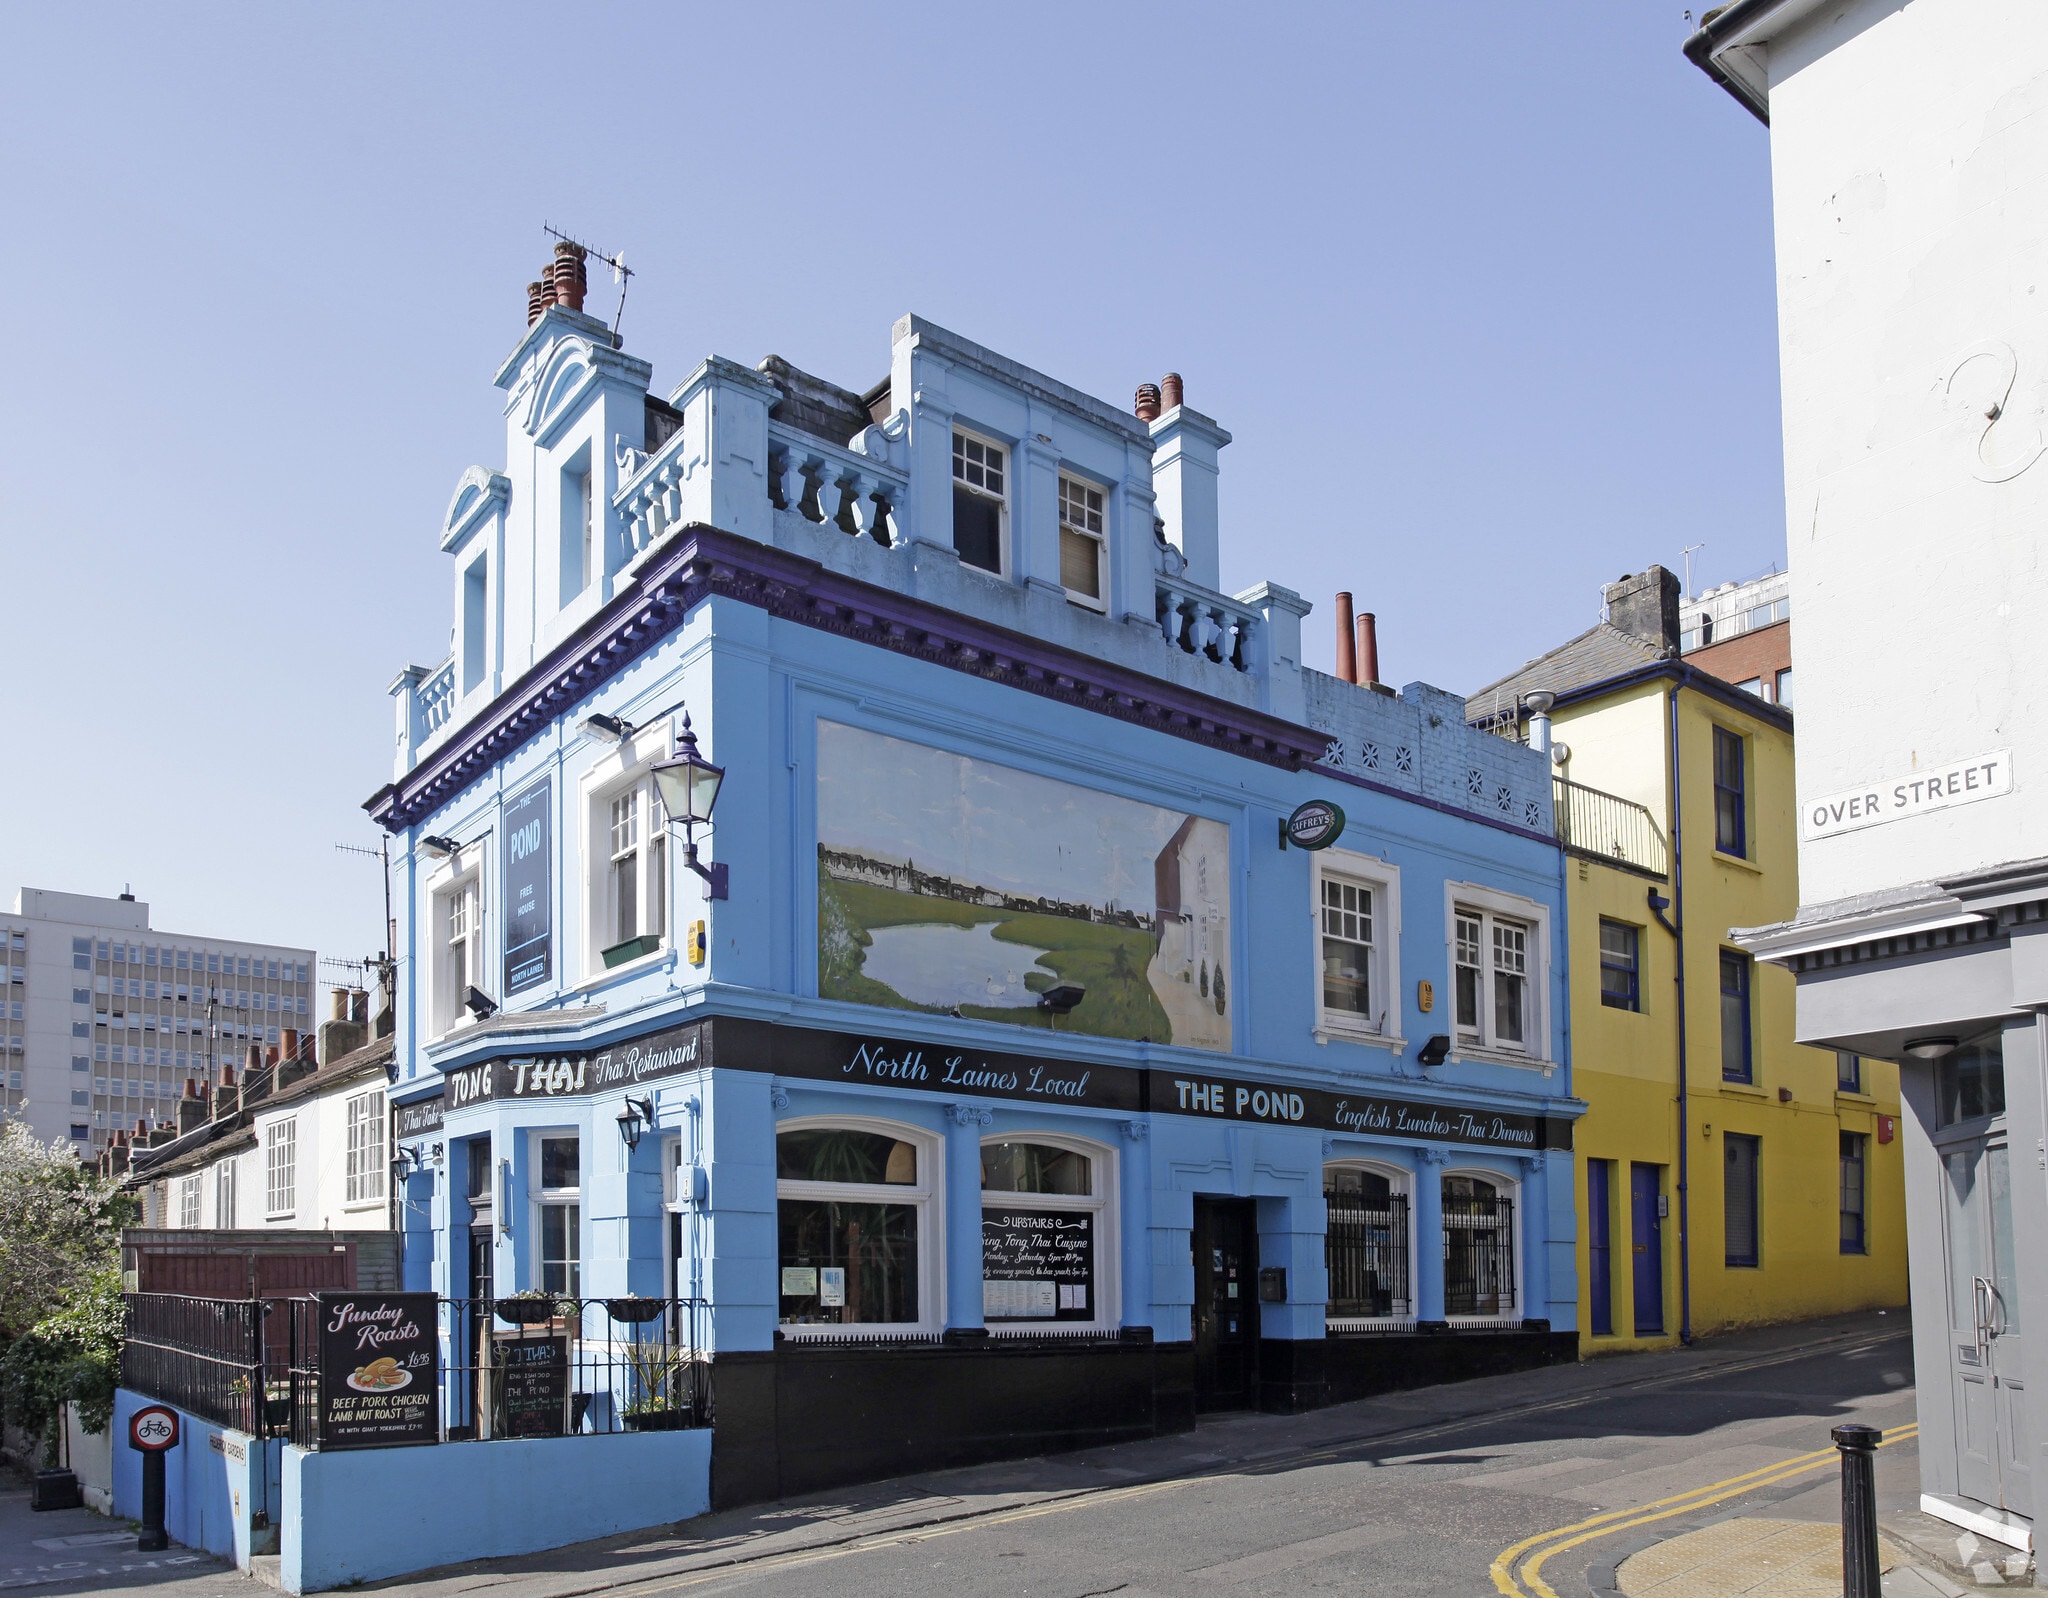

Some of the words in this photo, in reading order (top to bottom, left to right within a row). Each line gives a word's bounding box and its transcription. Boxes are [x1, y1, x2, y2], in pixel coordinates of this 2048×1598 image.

[519, 794, 532, 809] THE
[1813, 793, 1880, 827] OVER
[1893, 762, 1998, 808] STREET
[1291, 814, 1331, 833] CAFFREY'S
[511, 818, 541, 864] POND
[519, 884, 533, 899] FREE
[517, 900, 536, 917] HOUSE
[511, 968, 527, 984] NORTH
[527, 962, 544, 978] LAINES
[452, 1064, 492, 1107] TONG
[508, 1057, 587, 1095] THAI
[595, 1054, 625, 1085] Thai
[625, 1037, 698, 1082] Restaurant
[843, 1043, 930, 1081] North
[942, 1056, 1018, 1089] Laines
[1026, 1065, 1091, 1098] Local
[1174, 1080, 1225, 1113] THE
[1235, 1086, 1305, 1121] POND
[404, 1110, 422, 1132] Thai
[1335, 1100, 1392, 1132] English
[1488, 1117, 1534, 1144] Dinners
[1011, 1217, 1054, 1229] UPSTAIRS
[1005, 1234, 1029, 1251] Tong
[1031, 1234, 1053, 1248] Thai
[1055, 1234, 1088, 1250] Cuisine
[983, 1252, 1009, 1264] Monday
[1015, 1252, 1046, 1265] Saturday
[328, 1303, 403, 1333] Sunday
[355, 1321, 420, 1350] Roasts
[333, 1396, 358, 1409] BEEF
[362, 1396, 388, 1408] PORK
[391, 1394, 430, 1406] CHICKEN
[328, 1410, 353, 1423] LAMB
[355, 1409, 373, 1421] NUT
[374, 1408, 402, 1420] ROAST
